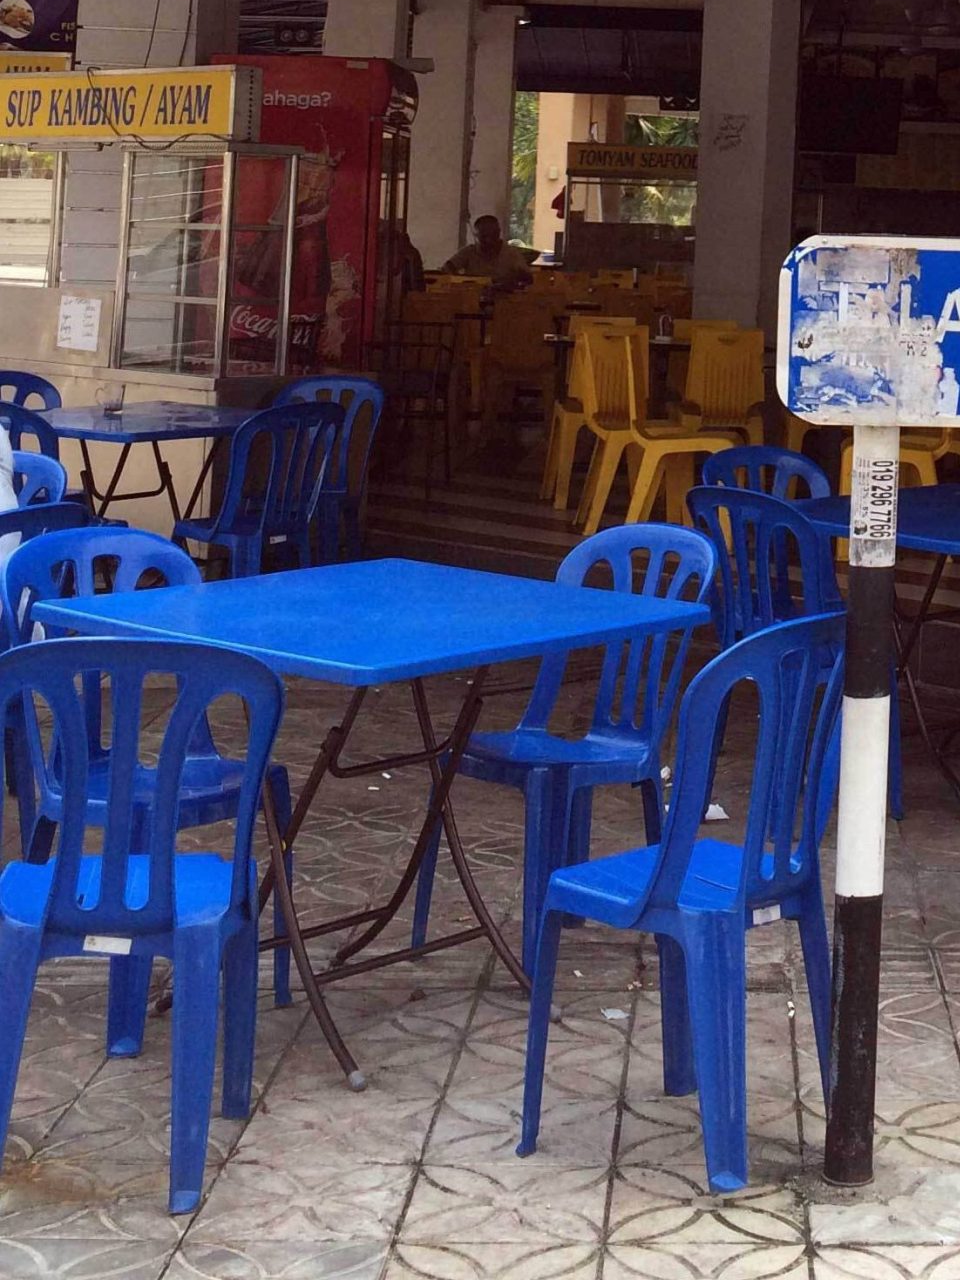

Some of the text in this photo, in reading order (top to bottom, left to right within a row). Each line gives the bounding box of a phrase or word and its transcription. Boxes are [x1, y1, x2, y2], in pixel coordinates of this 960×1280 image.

[6, 89, 42, 127] SUP
[47, 85, 137, 127] KAMBING
[154, 84, 213, 125] AYAM
[579, 148, 635, 167] TOMYAM
[869, 460, 894, 538] 019 296 7766
